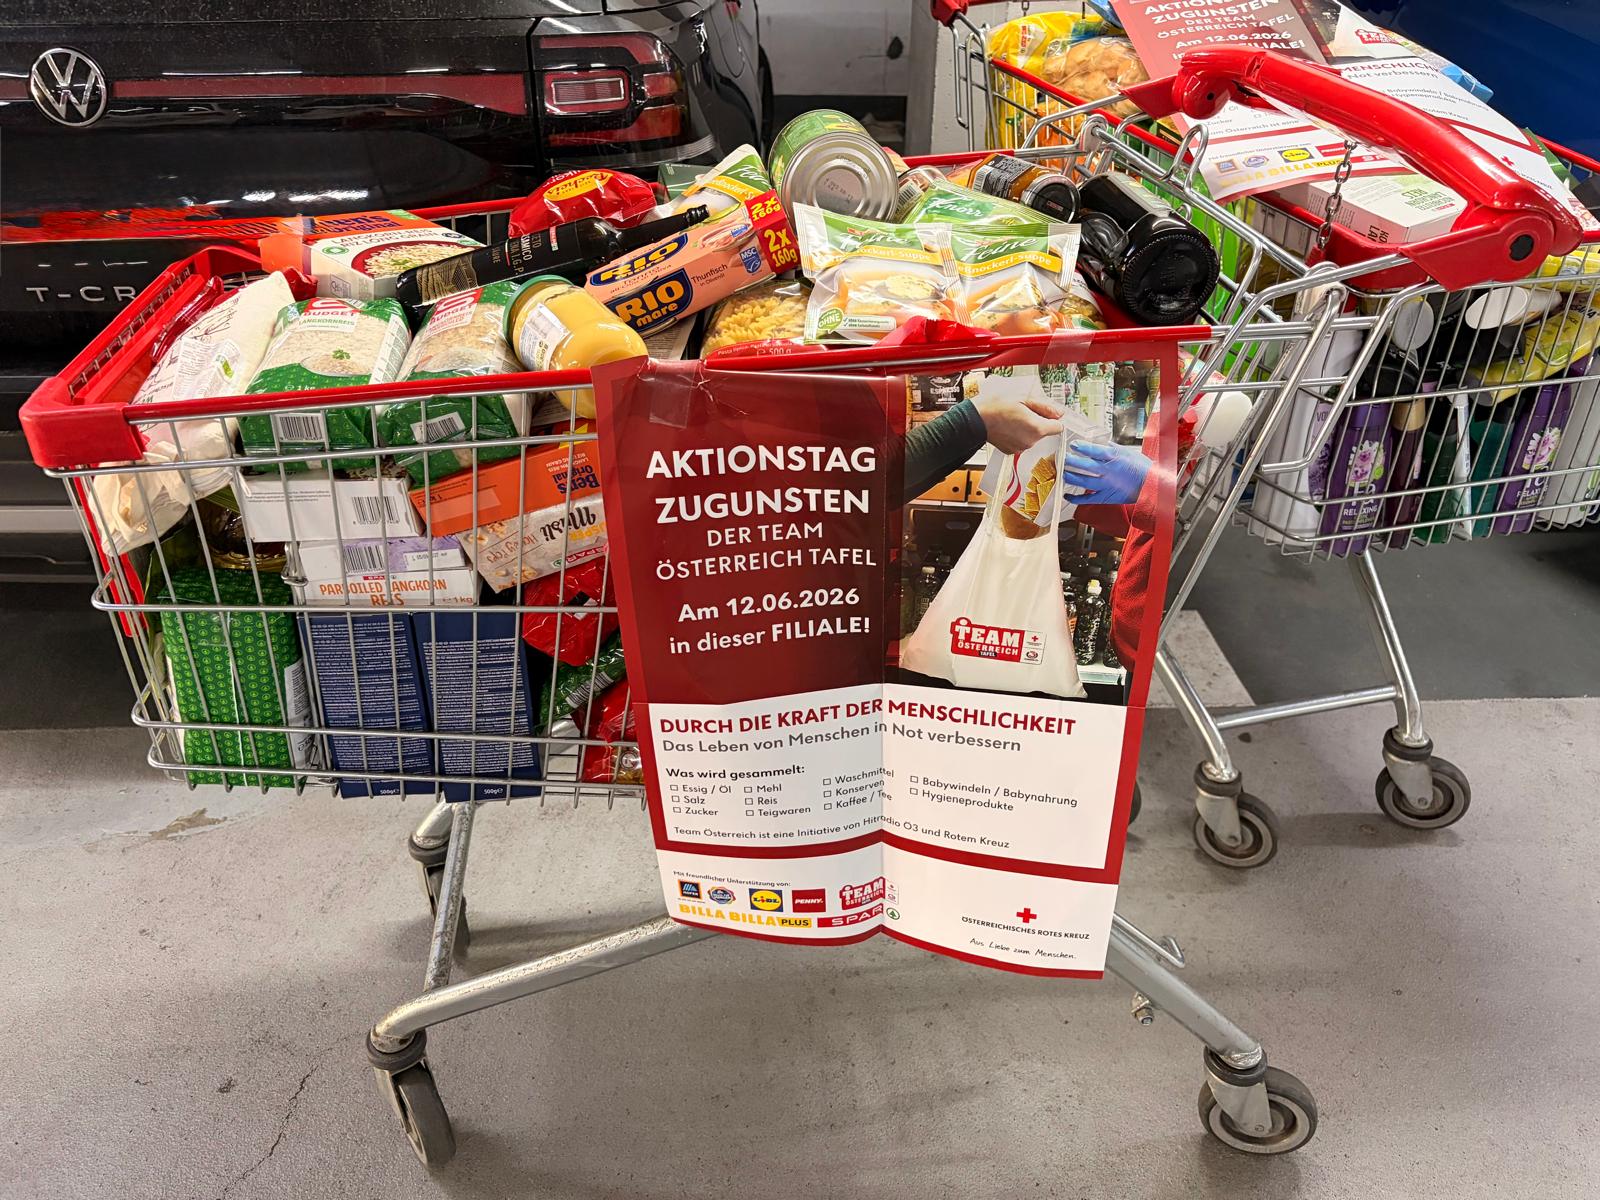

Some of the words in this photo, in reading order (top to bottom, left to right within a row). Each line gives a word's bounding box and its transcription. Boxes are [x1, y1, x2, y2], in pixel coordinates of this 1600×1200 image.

[1157, 22, 1249, 39] ÖSTERREICH
[1249, 14, 1294, 28] TAFEL
[1216, 13, 1256, 22] TEAM
[1175, 39, 1203, 49] Am
[1206, 31, 1292, 43] 12.06.2026
[751, 197, 778, 215] 2x
[752, 204, 782, 220] 160g
[764, 229, 792, 252] 2x
[600, 241, 679, 281] RIO
[741, 248, 757, 259] MSC
[772, 248, 798, 268] 160g
[690, 262, 729, 284] Thunfisch
[614, 280, 685, 323] RIO
[636, 301, 679, 327] mare
[819, 313, 841, 329] OHNE
[646, 445, 876, 479] AKTIONSTAG
[655, 487, 870, 524] ZUGUNSTEN
[1343, 504, 1378, 516] RELXING
[707, 527, 751, 547] DER
[758, 522, 823, 541] TEAM
[656, 549, 802, 580] ÖSTERREICH
[809, 548, 877, 566] TAFEL
[390, 578, 448, 592] ANGKORN
[678, 603, 719, 623] Am
[726, 588, 860, 617] 12.06.2026
[669, 637, 691, 654] in
[697, 630, 766, 652] dieser
[771, 617, 870, 642] FILIALE!
[954, 624, 1020, 648] TEAM
[957, 639, 1019, 656] ÖSTERREICH
[660, 718, 733, 733] DURCH
[739, 714, 772, 732] DIE
[777, 704, 841, 728] KRAFT
[845, 698, 883, 718] DER
[888, 699, 1077, 736] MENSCHLICHKEIT
[663, 740, 694, 752] Das
[698, 739, 749, 753] Leben
[753, 739, 784, 750] von
[789, 726, 870, 747] Menschen
[874, 721, 888, 733] in
[892, 722, 923, 740] Not
[928, 730, 1021, 752] verbessern
[666, 768, 694, 779] Was
[697, 769, 727, 780] wird
[730, 765, 805, 782] gesammelt:
[835, 767, 895, 785] Waschmittel
[682, 784, 708, 795] Essig
[719, 783, 732, 794] Öl
[757, 784, 782, 793] Mehl
[835, 779, 885, 797] Konserven
[922, 777, 991, 796] Babywindeln
[1003, 788, 1078, 808] Babynahrung
[684, 795, 706, 805] Salz
[758, 796, 778, 806] Reis
[836, 795, 867, 809] Kaffee
[877, 790, 892, 801] Tee
[922, 790, 1014, 811] Hygieneprodukte
[685, 807, 719, 816] Zucker
[758, 806, 811, 818] Teigwaren
[674, 827, 701, 837] Team
[703, 828, 756, 839] Österreich
[759, 829, 771, 839] ist
[773, 830, 795, 839] eine
[797, 825, 841, 837] Initiative
[843, 821, 861, 832] von
[863, 815, 901, 828] Hitradio
[921, 827, 941, 837] und
[943, 830, 977, 843] Rotem
[980, 836, 1010, 849] Kreuz
[685, 872, 726, 883] freundlicher
[726, 877, 775, 888] Unterstützung
[842, 882, 884, 900] TEAM
[679, 904, 728, 920] BILLA
[729, 910, 780, 926] BILLA
[781, 918, 809, 927] PLUS
[831, 904, 884, 926] SPAR
[961, 916, 1036, 935] ÖSTERREICHISCHES
[1037, 929, 1063, 938] ROTES
[969, 937, 985, 947] Aus
[989, 941, 1011, 952] Liebe
[1034, 948, 1077, 959] Menschen.
